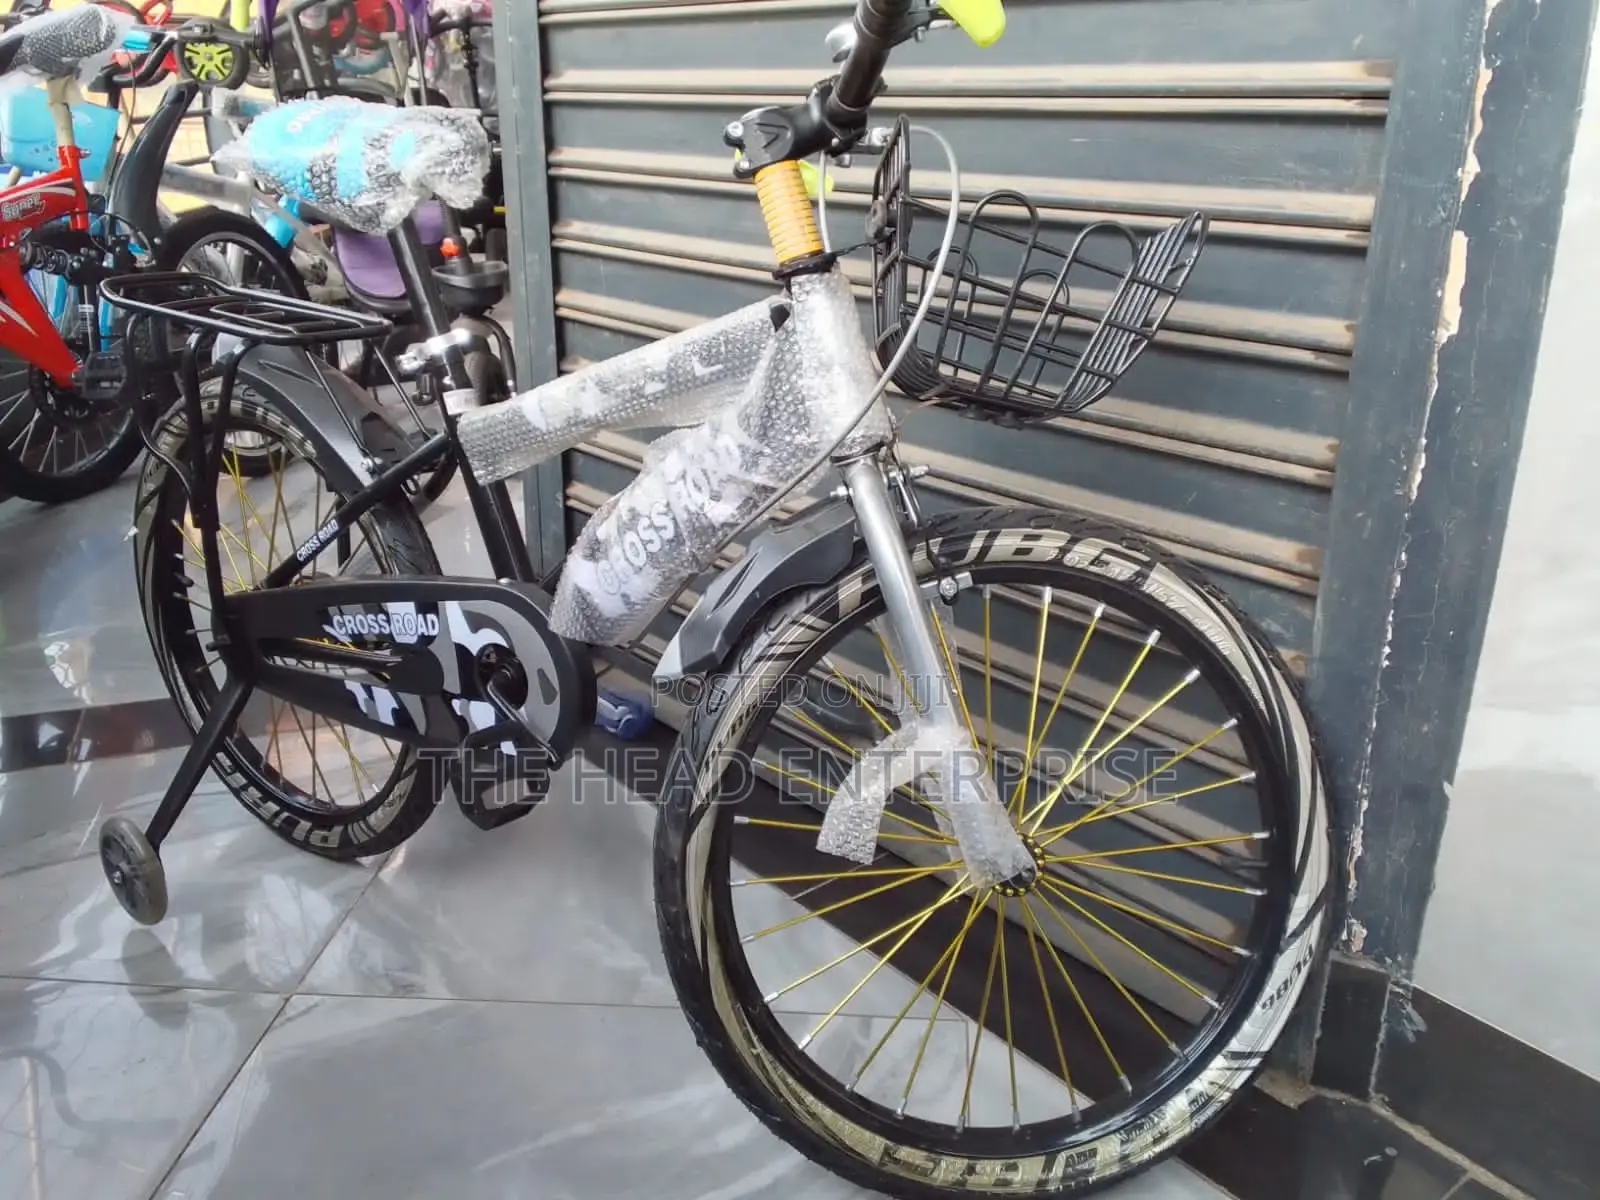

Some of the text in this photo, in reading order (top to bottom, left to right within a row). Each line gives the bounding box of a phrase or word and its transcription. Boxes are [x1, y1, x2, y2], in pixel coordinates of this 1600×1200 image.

[296, 519, 339, 562] CROSS ROAD
[332, 613, 439, 637] CROSS ROAD
[1260, 943, 1314, 1011] PUBG
